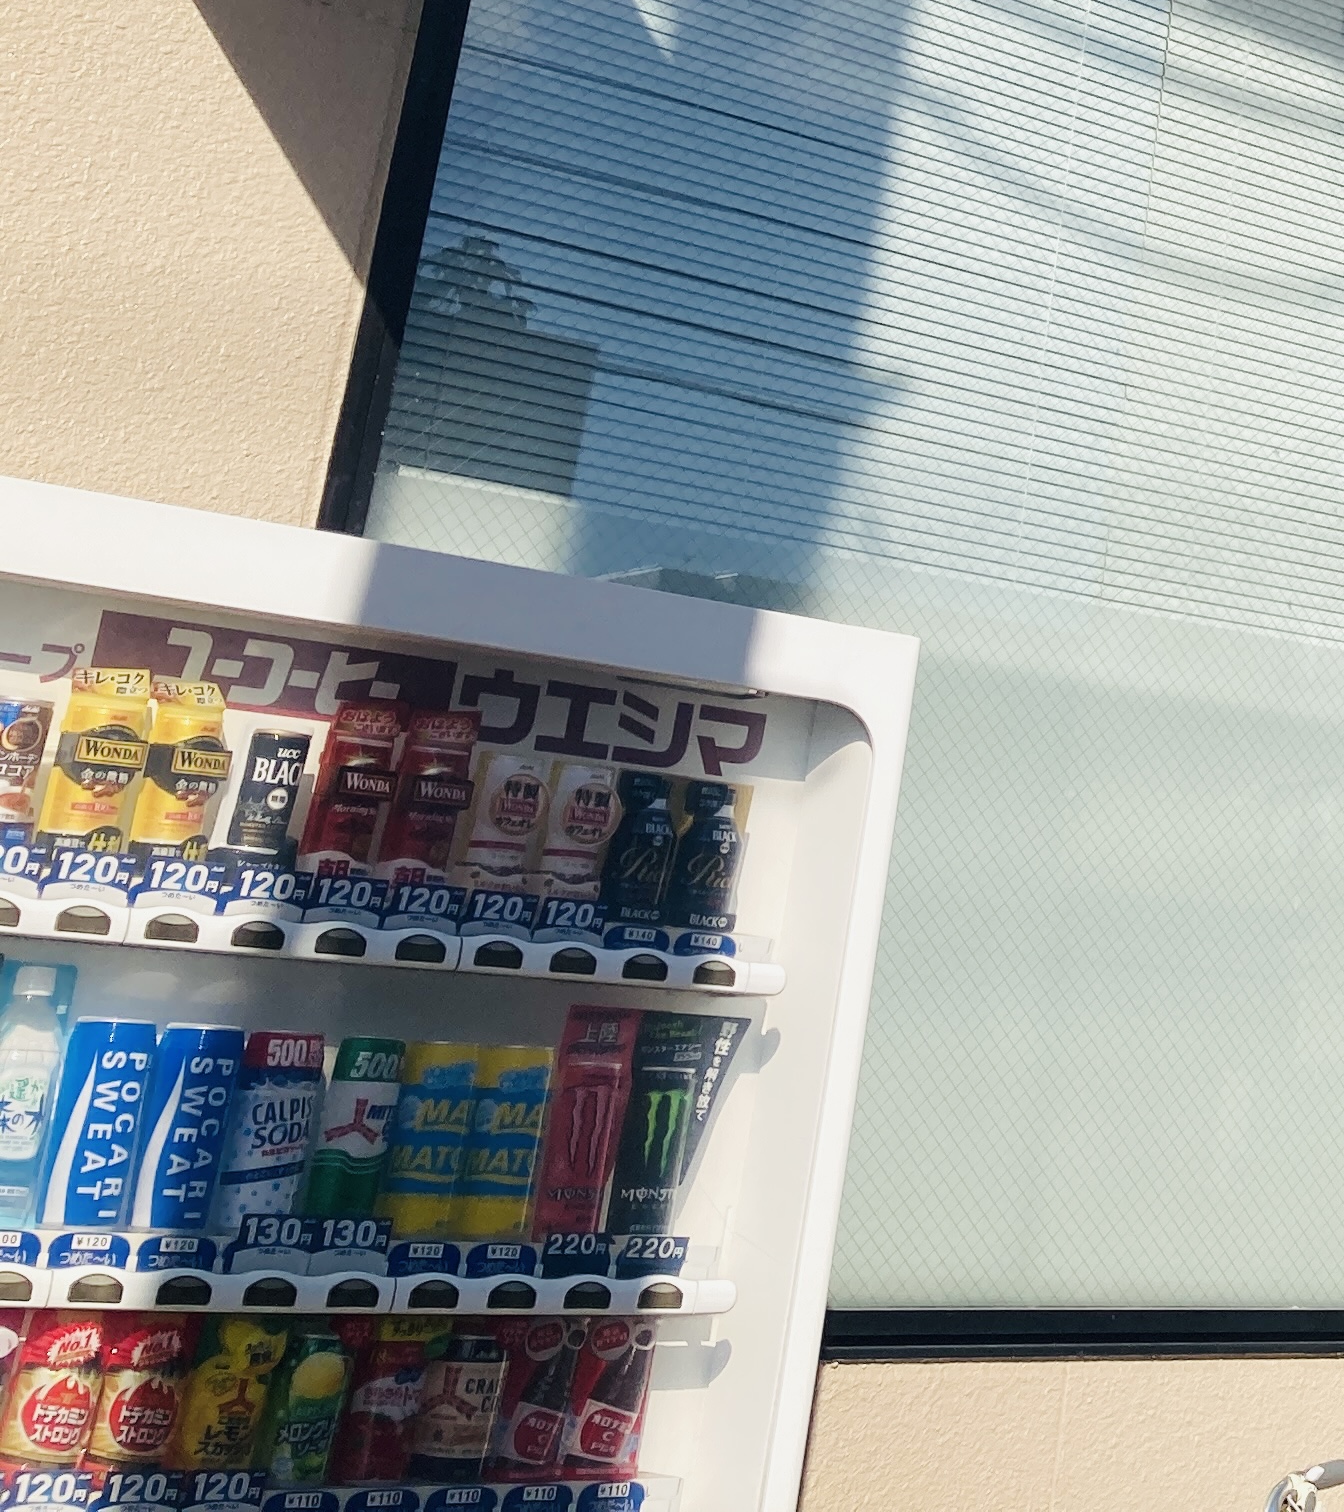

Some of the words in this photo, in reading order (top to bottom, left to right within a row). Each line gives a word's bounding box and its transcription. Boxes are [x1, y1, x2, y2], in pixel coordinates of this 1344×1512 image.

[76, 669, 146, 686] キレ・コク
[458, 668, 767, 777] ウエシマ
[84, 738, 141, 762] WONDA
[180, 751, 227, 772] WONDA
[346, 771, 391, 794] WONDA
[420, 780, 467, 802] WONDA
[58, 851, 131, 885] 120円
[150, 860, 220, 894] 120円
[240, 869, 306, 901] 120円
[318, 878, 382, 908] 120円
[399, 886, 459, 916] 120円
[473, 892, 533, 923] 120円
[545, 900, 604, 930] 120円
[251, 1094, 316, 1125] CALPIS
[76, 1050, 125, 1202] SWEAT
[97, 1051, 151, 1220] POCARI
[162, 1055, 213, 1204] SWEAT
[183, 1057, 236, 1220] POCARI
[250, 1123, 310, 1150] SODA
[76, 1236, 108, 1248] ¥120
[245, 1217, 312, 1246] 130円
[322, 1219, 388, 1248] 130円
[547, 1233, 606, 1256] 220円
[626, 1238, 684, 1260] 220円
[58, 1332, 93, 1354] No.1
[32, 1403, 88, 1426] ドデカミン
[118, 1405, 172, 1427] ドデカミン
[30, 1424, 82, 1446] ストロング
[116, 1424, 170, 1446] ストロング
[15, 1471, 87, 1503] 120円
[108, 1472, 178, 1503] 120円
[194, 1471, 261, 1503] 120円
